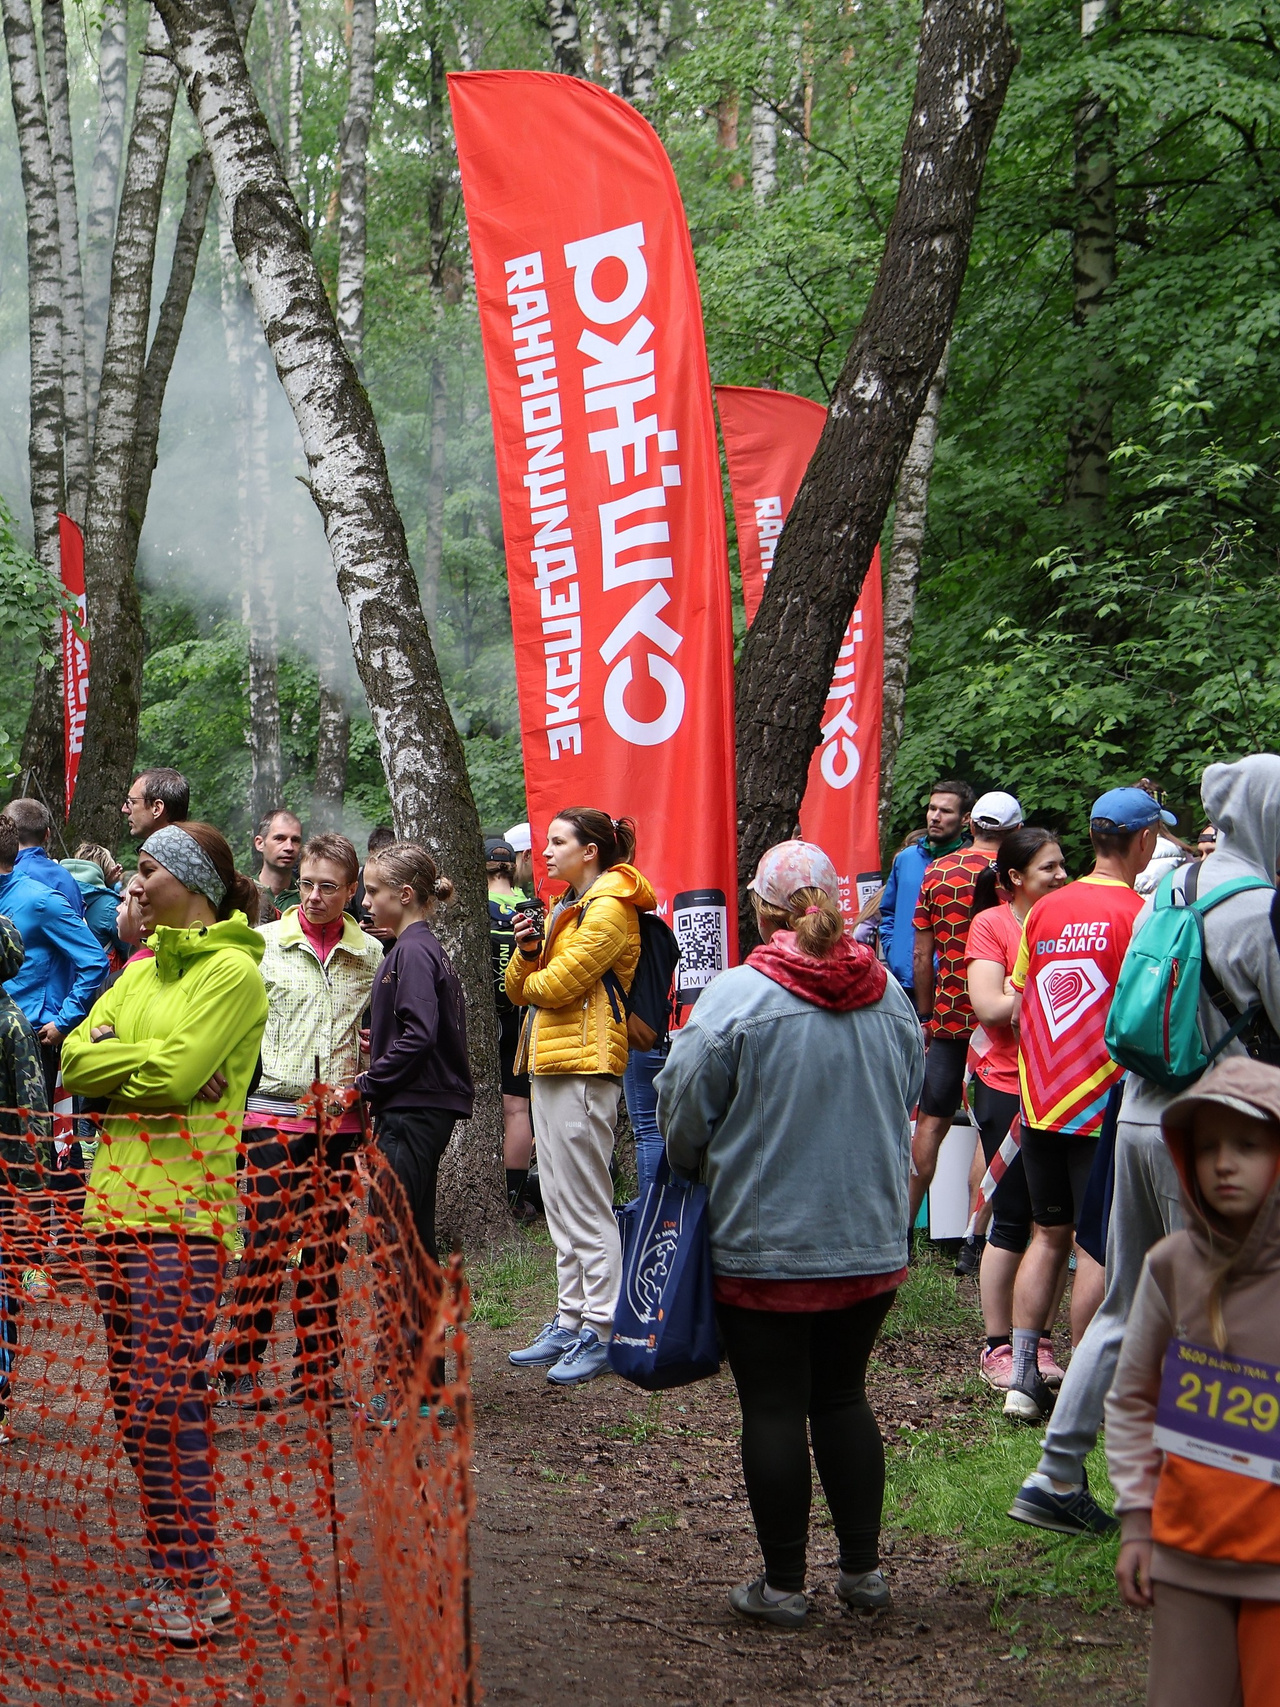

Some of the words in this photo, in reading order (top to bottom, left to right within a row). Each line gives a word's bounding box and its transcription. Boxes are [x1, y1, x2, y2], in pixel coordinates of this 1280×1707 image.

[1060, 921, 1110, 938] АТЛЕТ
[1036, 936, 1108, 955] ВОБЛАГО
[1243, 1365, 1270, 1380] TRAIL
[1175, 1372, 1280, 1433] 2129
